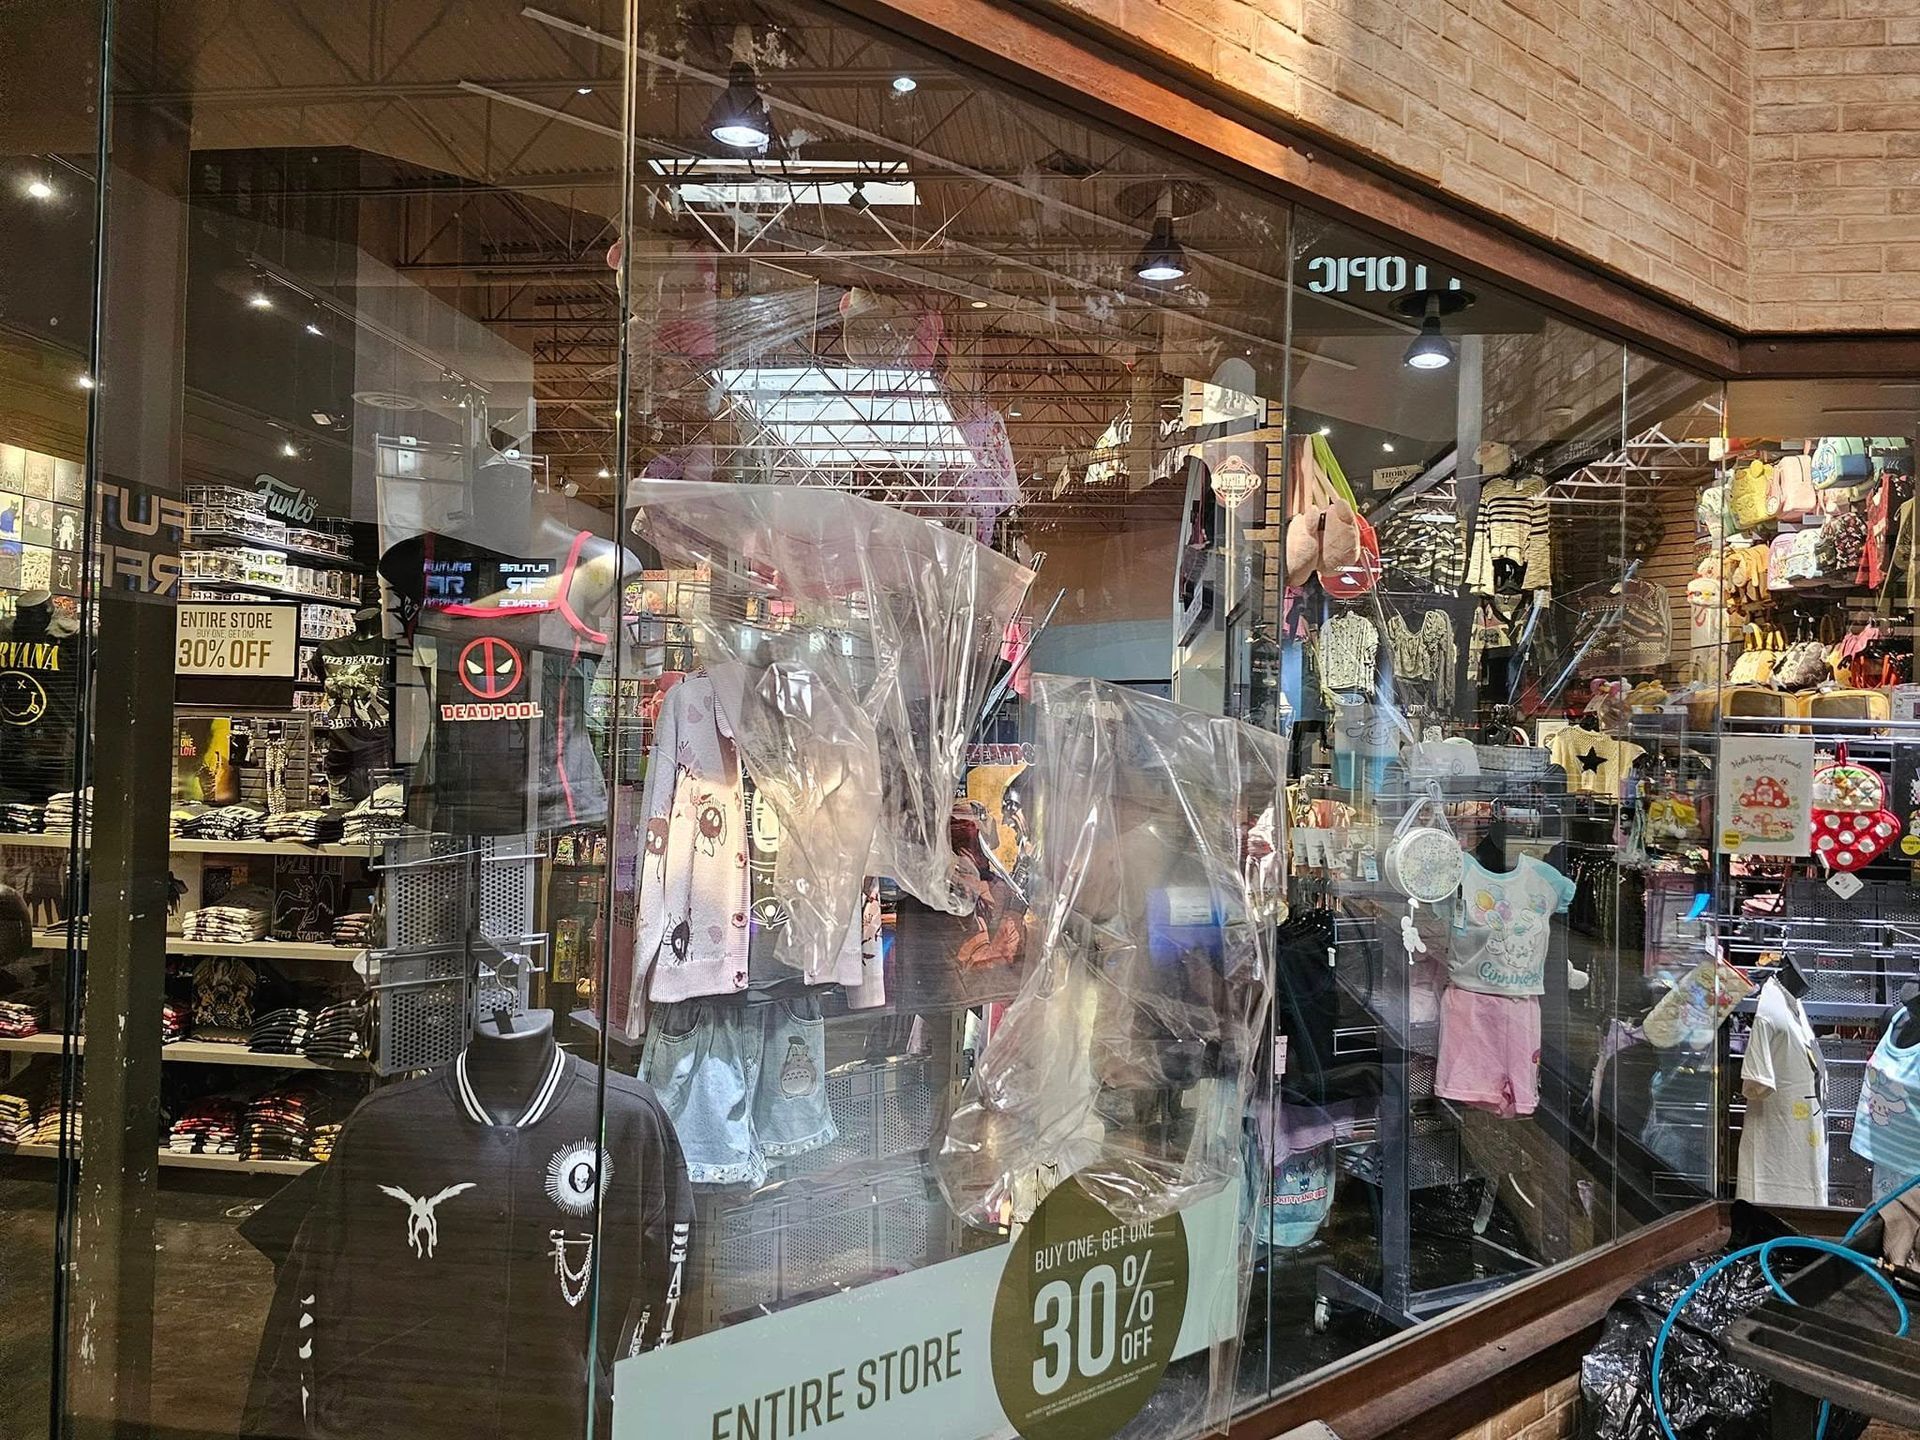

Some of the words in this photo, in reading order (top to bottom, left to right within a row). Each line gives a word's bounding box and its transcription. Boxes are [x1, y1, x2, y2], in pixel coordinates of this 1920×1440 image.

[256, 474, 314, 523] Funko
[181, 611, 227, 628] ENTIRE
[231, 612, 273, 629] STORE
[196, 629, 209, 638] BUY
[228, 630, 241, 638] GET
[242, 630, 255, 639] ONE
[178, 638, 225, 668] 30%
[229, 639, 272, 669] OFF
[441, 701, 543, 721] DEADPOOL
[180, 747, 197, 756] LOVE
[181, 738, 194, 747] ONE
[1035, 1244, 1063, 1273] BUY
[1068, 1234, 1098, 1262] ONE,
[1102, 1225, 1127, 1252] GET
[1032, 1249, 1154, 1396] 30%
[1121, 1325, 1153, 1365] OFF
[856, 1328, 963, 1411] STORE
